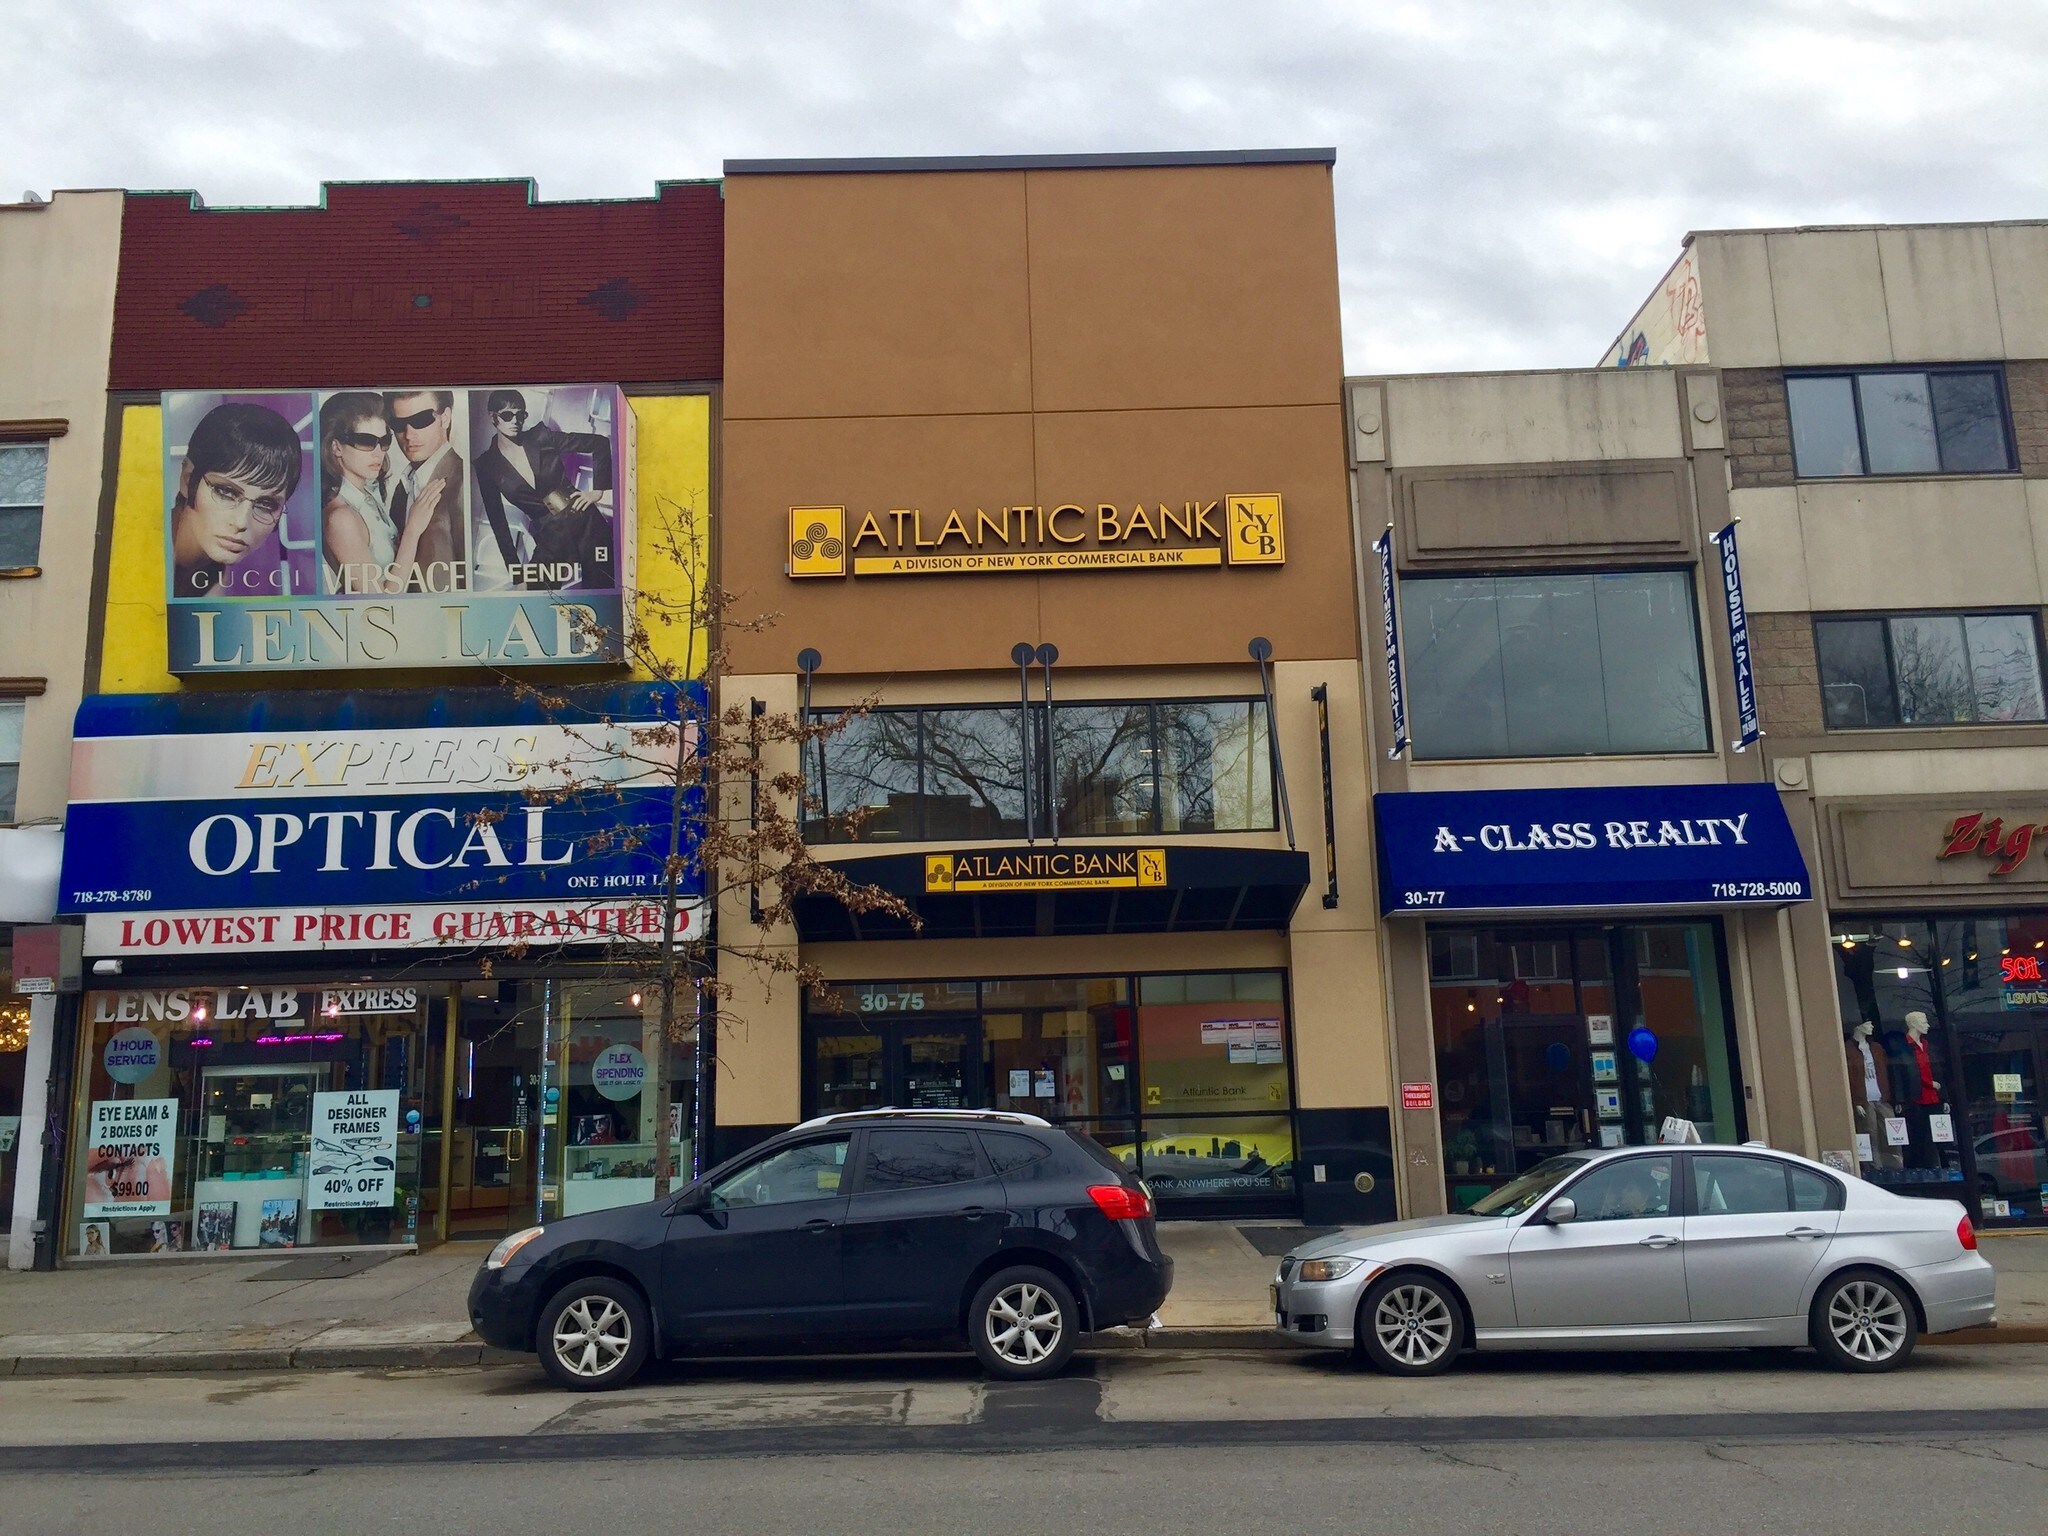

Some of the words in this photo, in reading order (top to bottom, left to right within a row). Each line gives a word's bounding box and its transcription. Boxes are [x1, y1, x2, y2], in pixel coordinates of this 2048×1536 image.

[852, 503, 1087, 549] ATLANTIC
[1097, 501, 1222, 543] BANK
[893, 560, 902, 570] A
[907, 558, 962, 569] DIVISION
[966, 557, 983, 568] OF
[988, 556, 1017, 567] NEW
[1019, 555, 1053, 567] YORK
[1057, 553, 1146, 565] COMMERCIAL
[1150, 551, 1184, 562] BANK
[191, 569, 300, 590] GUCCI
[322, 561, 467, 595] VERSACE
[508, 562, 580, 585] FENDI
[1723, 533, 1743, 629] HOUSE
[191, 605, 399, 667] LENS
[439, 603, 600, 662] LAB
[1732, 629, 1746, 646] FOR
[1736, 645, 1752, 712] SALE
[1387, 659, 1400, 718] RENT
[234, 736, 538, 789] EXPRESS
[1433, 823, 1597, 853] A-CLASS
[1604, 812, 1749, 850] REALTY
[188, 805, 575, 877] OPTICAL
[954, 853, 1070, 877] ATLANTIC
[1073, 851, 1136, 874] BANK
[568, 876, 599, 888] ONE
[604, 874, 646, 887] HOUR
[1712, 881, 1802, 897] 718-728-5000
[73, 889, 152, 904] 718-278-8780
[1404, 891, 1445, 905] 30-77
[119, 916, 280, 948] LOWEST
[294, 913, 411, 943] PRICE
[433, 906, 690, 939] GUARANTEED
[2001, 956, 2042, 982] 501
[94, 989, 191, 1022] LENS
[214, 987, 299, 1020] LAB
[321, 987, 418, 1012] EXPRESS
[860, 992, 925, 1012] 30-75
[107, 1054, 156, 1066] SERVICE
[608, 1053, 632, 1064] FLEX
[596, 1067, 644, 1079] SPENDING
[347, 1094, 369, 1105] ALL
[1182, 1087, 1219, 1097] Atlantic
[1222, 1086, 1247, 1096] Bank
[99, 1107, 121, 1121] EYE
[124, 1105, 158, 1121] EXAM
[161, 1105, 170, 1120] &
[328, 1107, 387, 1120] DESIGNER
[100, 1126, 107, 1139] 2
[109, 1125, 142, 1139] BOXES
[145, 1124, 158, 1137] OF
[333, 1121, 380, 1134] FRAMES
[97, 1142, 160, 1158] CONTACTS
[112, 1181, 149, 1197] $99.00
[324, 1179, 353, 1194] 40%
[358, 1178, 384, 1193] OFF
[1148, 1179, 1174, 1189] BANK
[1176, 1178, 1230, 1189] ANYWHERE
[1231, 1178, 1252, 1187] YOU
[1254, 1177, 1271, 1187] SEE
[138, 1205, 157, 1213] Apply
[324, 1200, 360, 1208] Restrictions
[361, 1199, 380, 1207] Apply
